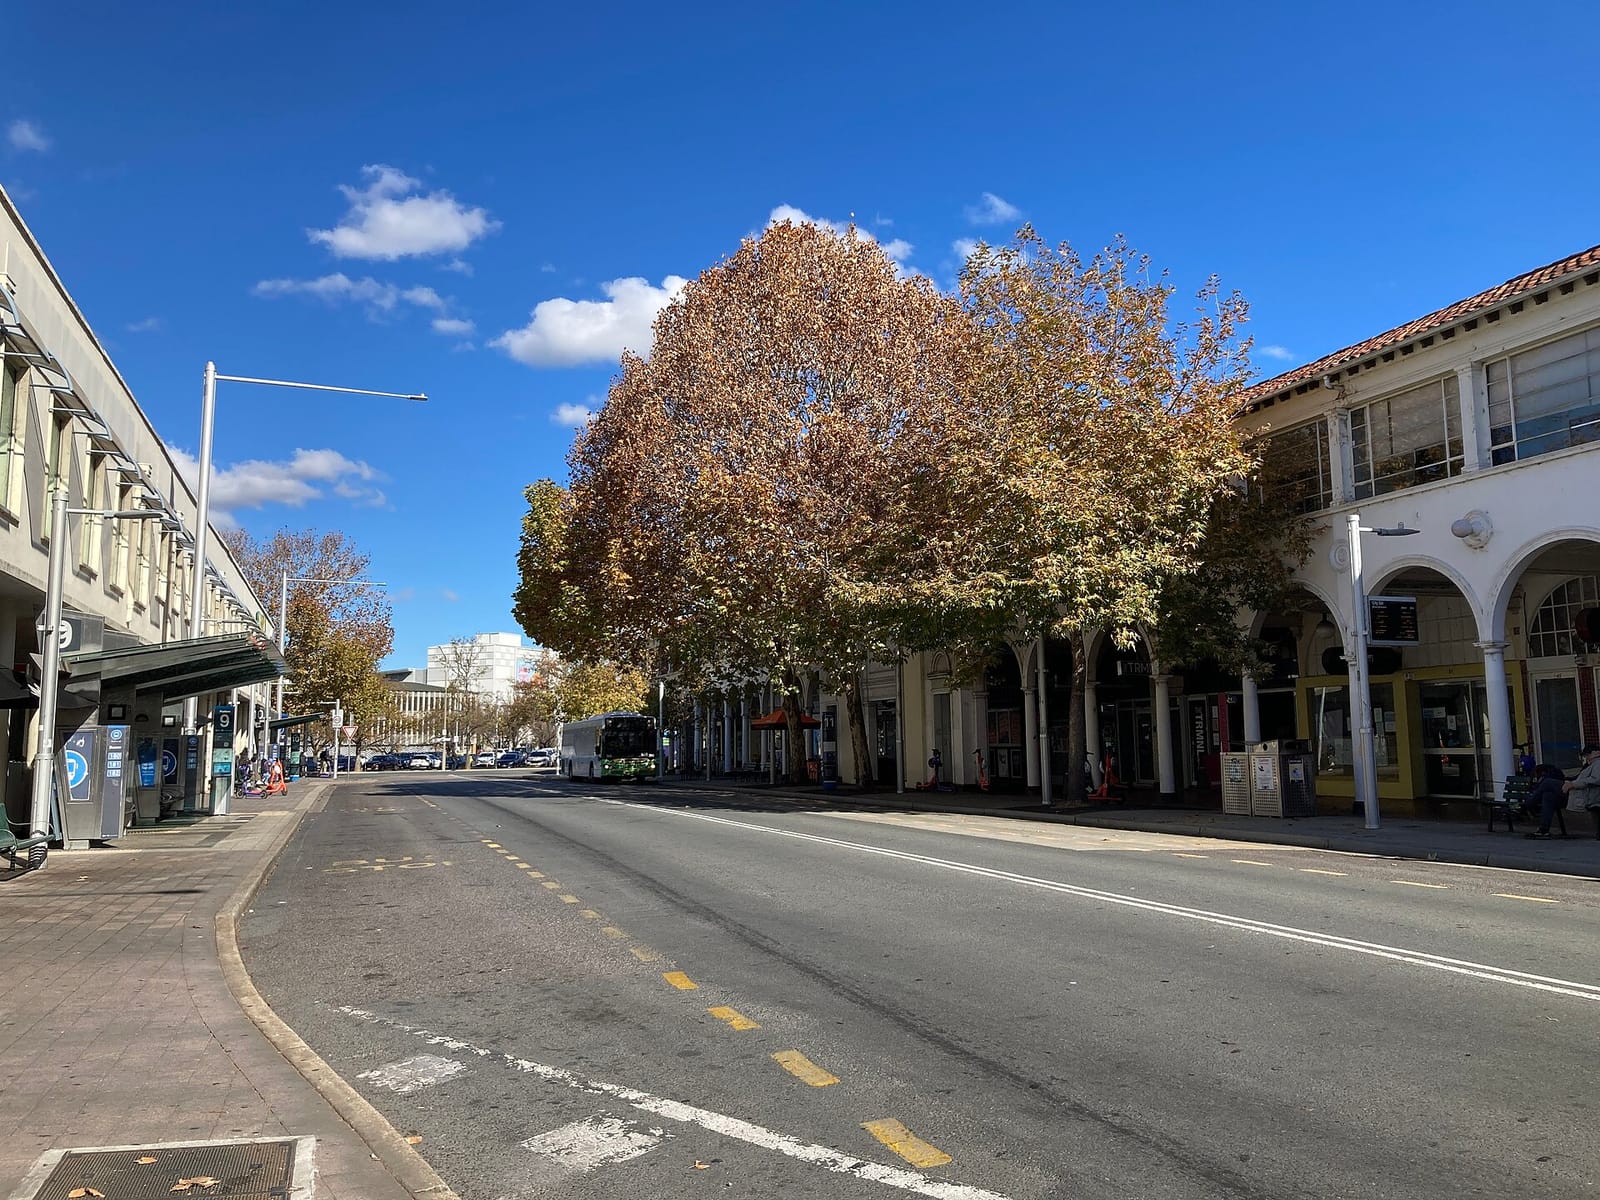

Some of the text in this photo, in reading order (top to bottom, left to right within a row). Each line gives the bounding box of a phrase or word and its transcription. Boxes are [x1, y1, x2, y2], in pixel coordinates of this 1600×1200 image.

[219, 714, 230, 728] 9
[824, 717, 834, 728] 11
[292, 735, 300, 743] 10
[1194, 713, 1205, 753] TRMNL
